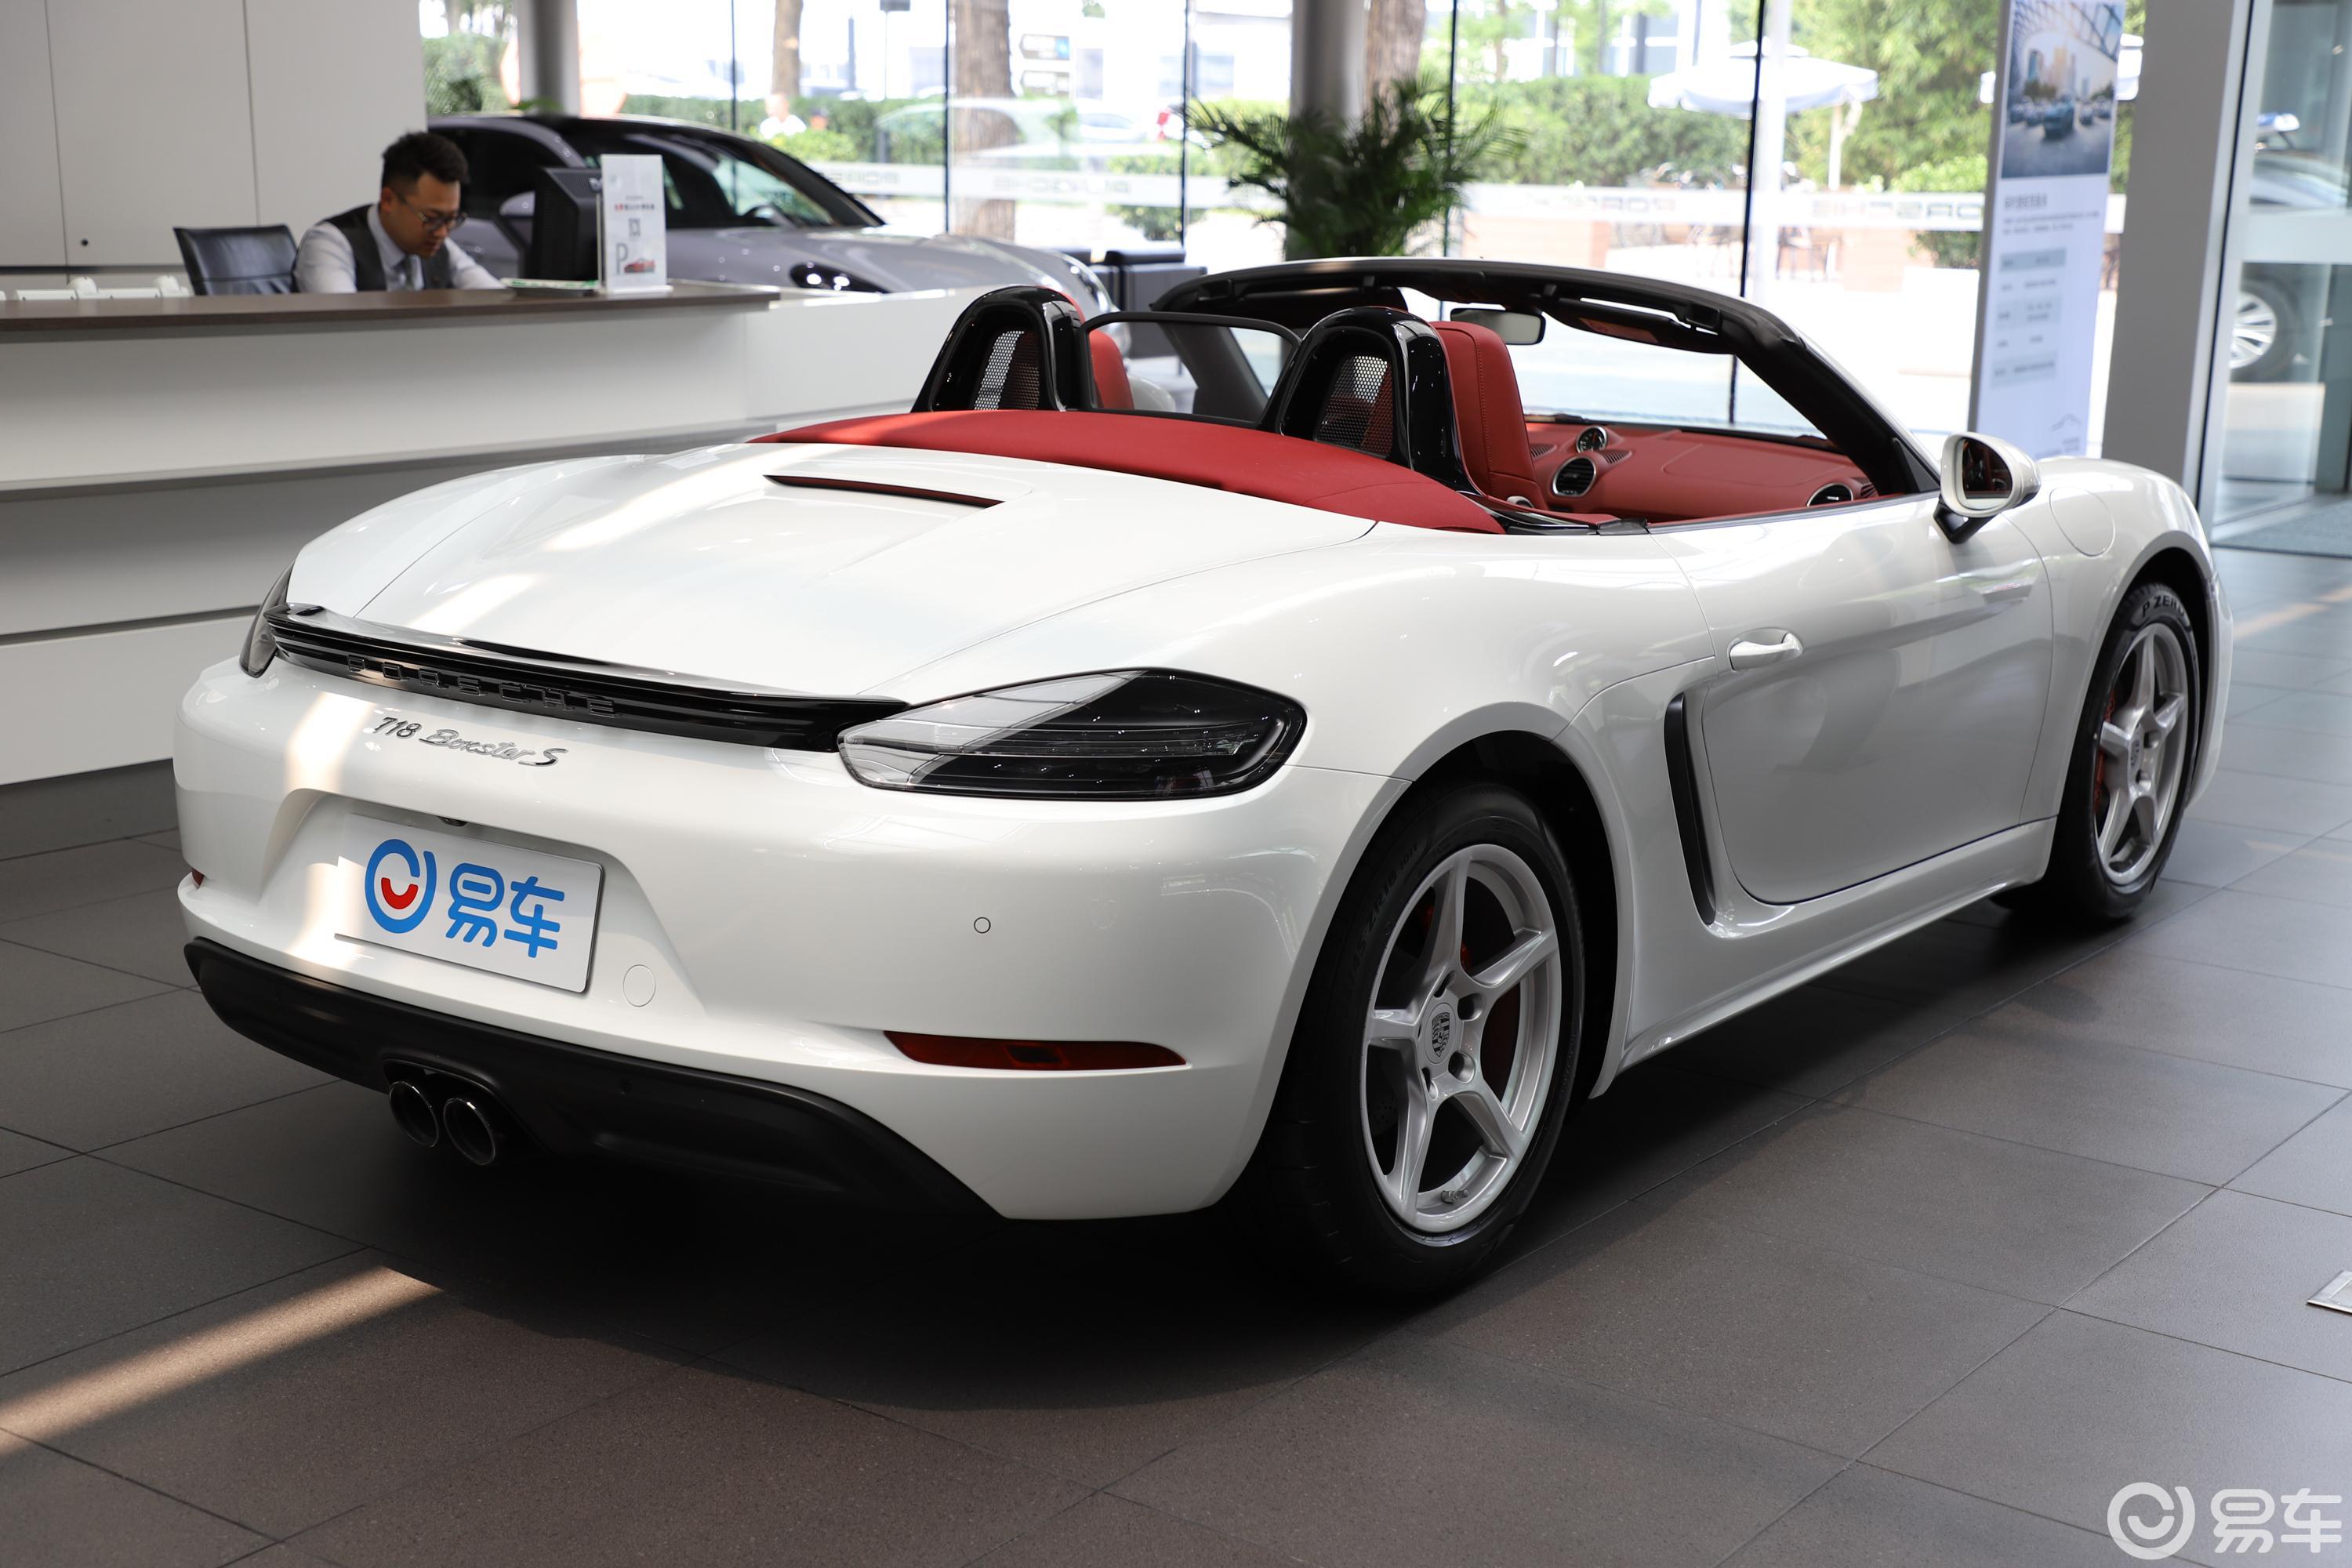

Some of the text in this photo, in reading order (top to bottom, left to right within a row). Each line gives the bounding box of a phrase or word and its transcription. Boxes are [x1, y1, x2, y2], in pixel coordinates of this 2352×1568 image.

[348, 657, 616, 717] PORSCHE
[374, 717, 569, 767] 718 Boxster S
[445, 862, 565, 958] 易车
